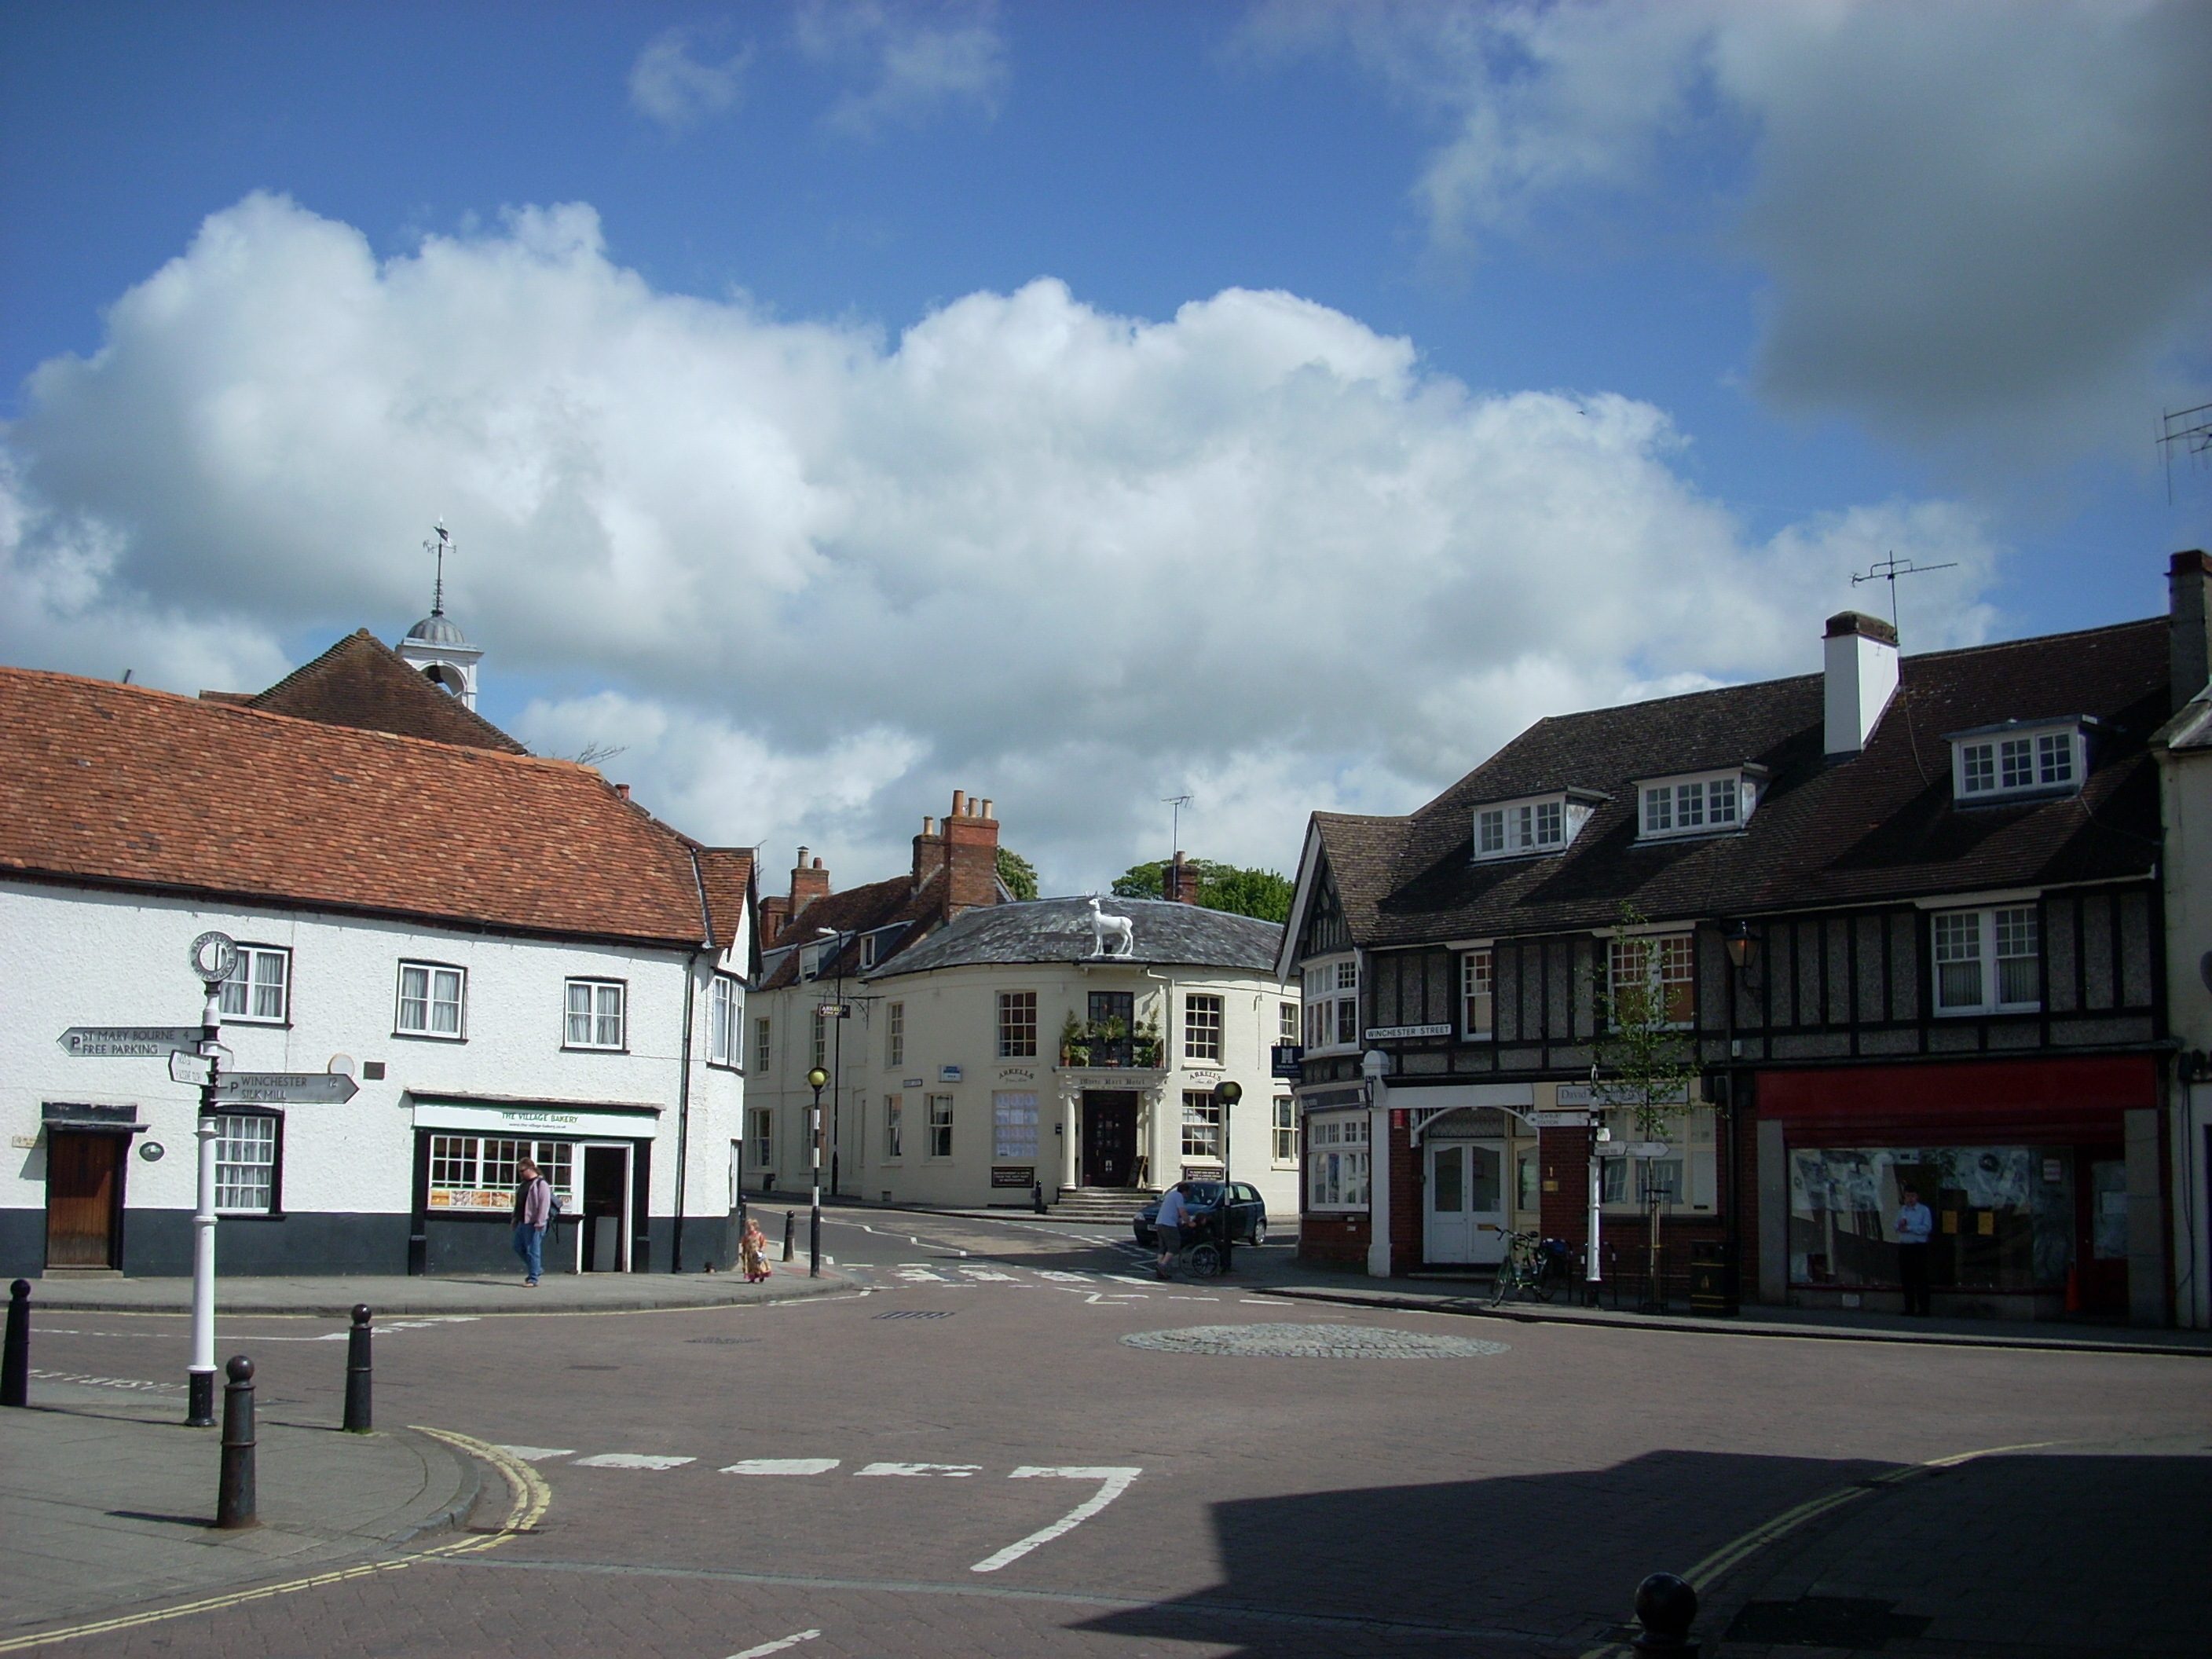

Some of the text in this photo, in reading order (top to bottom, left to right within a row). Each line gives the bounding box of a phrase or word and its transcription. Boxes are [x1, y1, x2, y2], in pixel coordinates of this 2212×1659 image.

[82, 1030, 189, 1041] ST MARY BOURNE 4
[1368, 1026, 1449, 1038] WINCHESTER STREET
[72, 1036, 80, 1048] P
[82, 1045, 158, 1055] FREE PARKING
[241, 1076, 338, 1087] WINCHESTER 12
[229, 1082, 239, 1093] P
[241, 1089, 286, 1100] SILK MILL
[1561, 1089, 1587, 1100] David
[518, 1112, 548, 1121] VILLAGE
[551, 1115, 579, 1123] BAKERY
